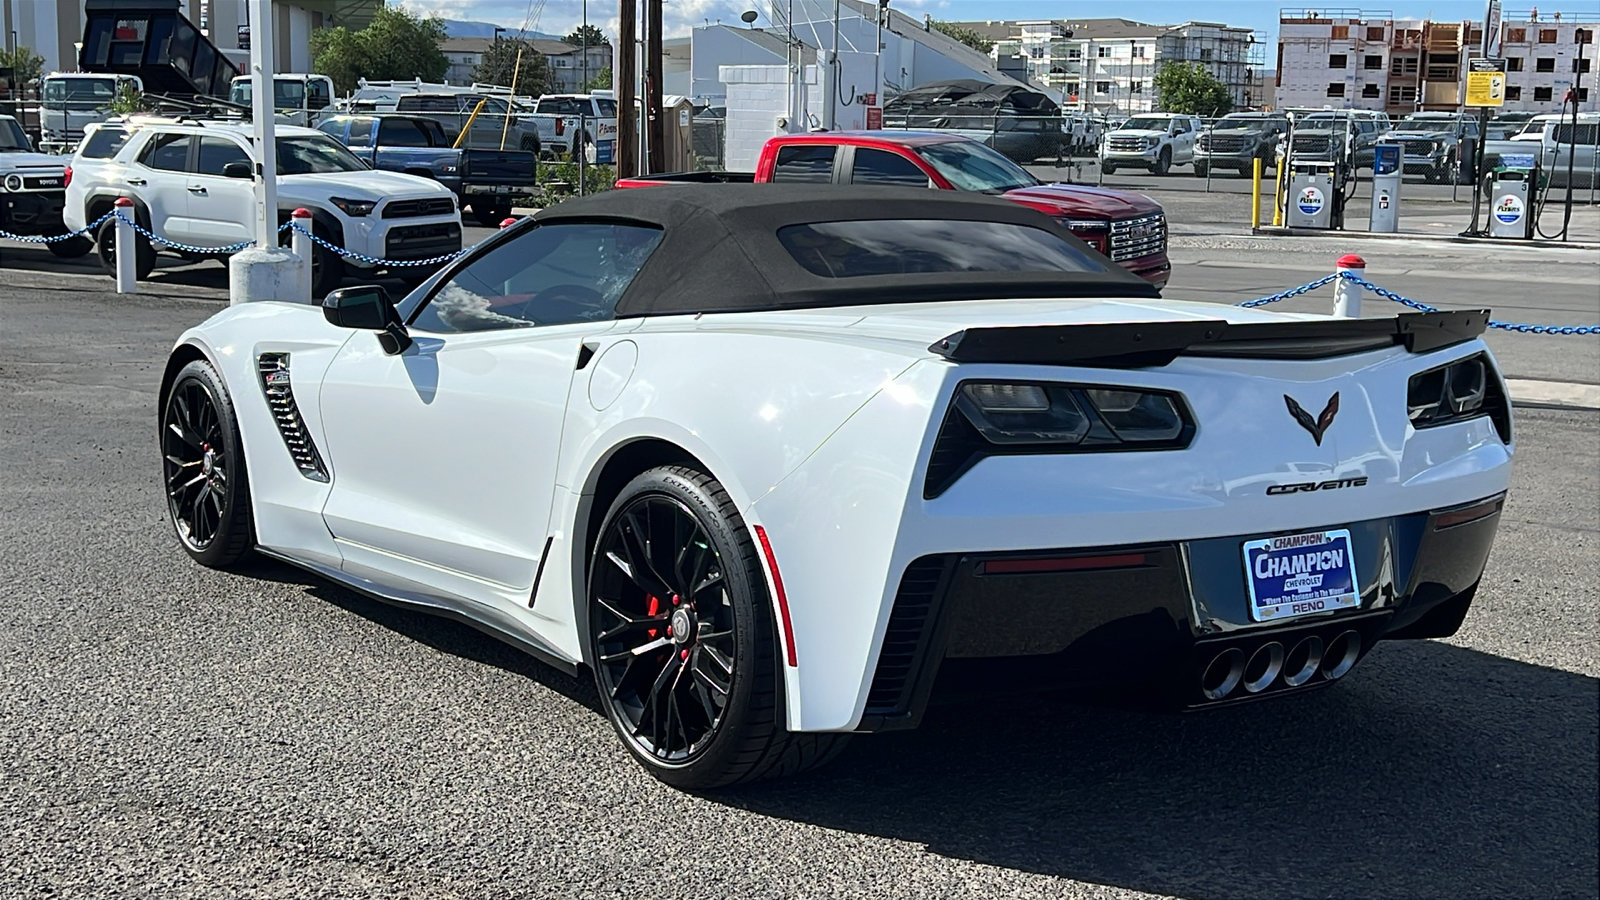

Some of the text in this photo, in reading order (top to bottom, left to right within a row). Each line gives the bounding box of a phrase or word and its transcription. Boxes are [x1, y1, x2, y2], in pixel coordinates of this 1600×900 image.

[1266, 476, 1368, 496] CORVETTE
[1273, 533, 1323, 549] CHAMPION
[1255, 549, 1344, 579] CHAMPION
[1285, 577, 1322, 588] CHEVROLET
[1282, 595, 1291, 603] The
[1293, 600, 1325, 614] RENO
